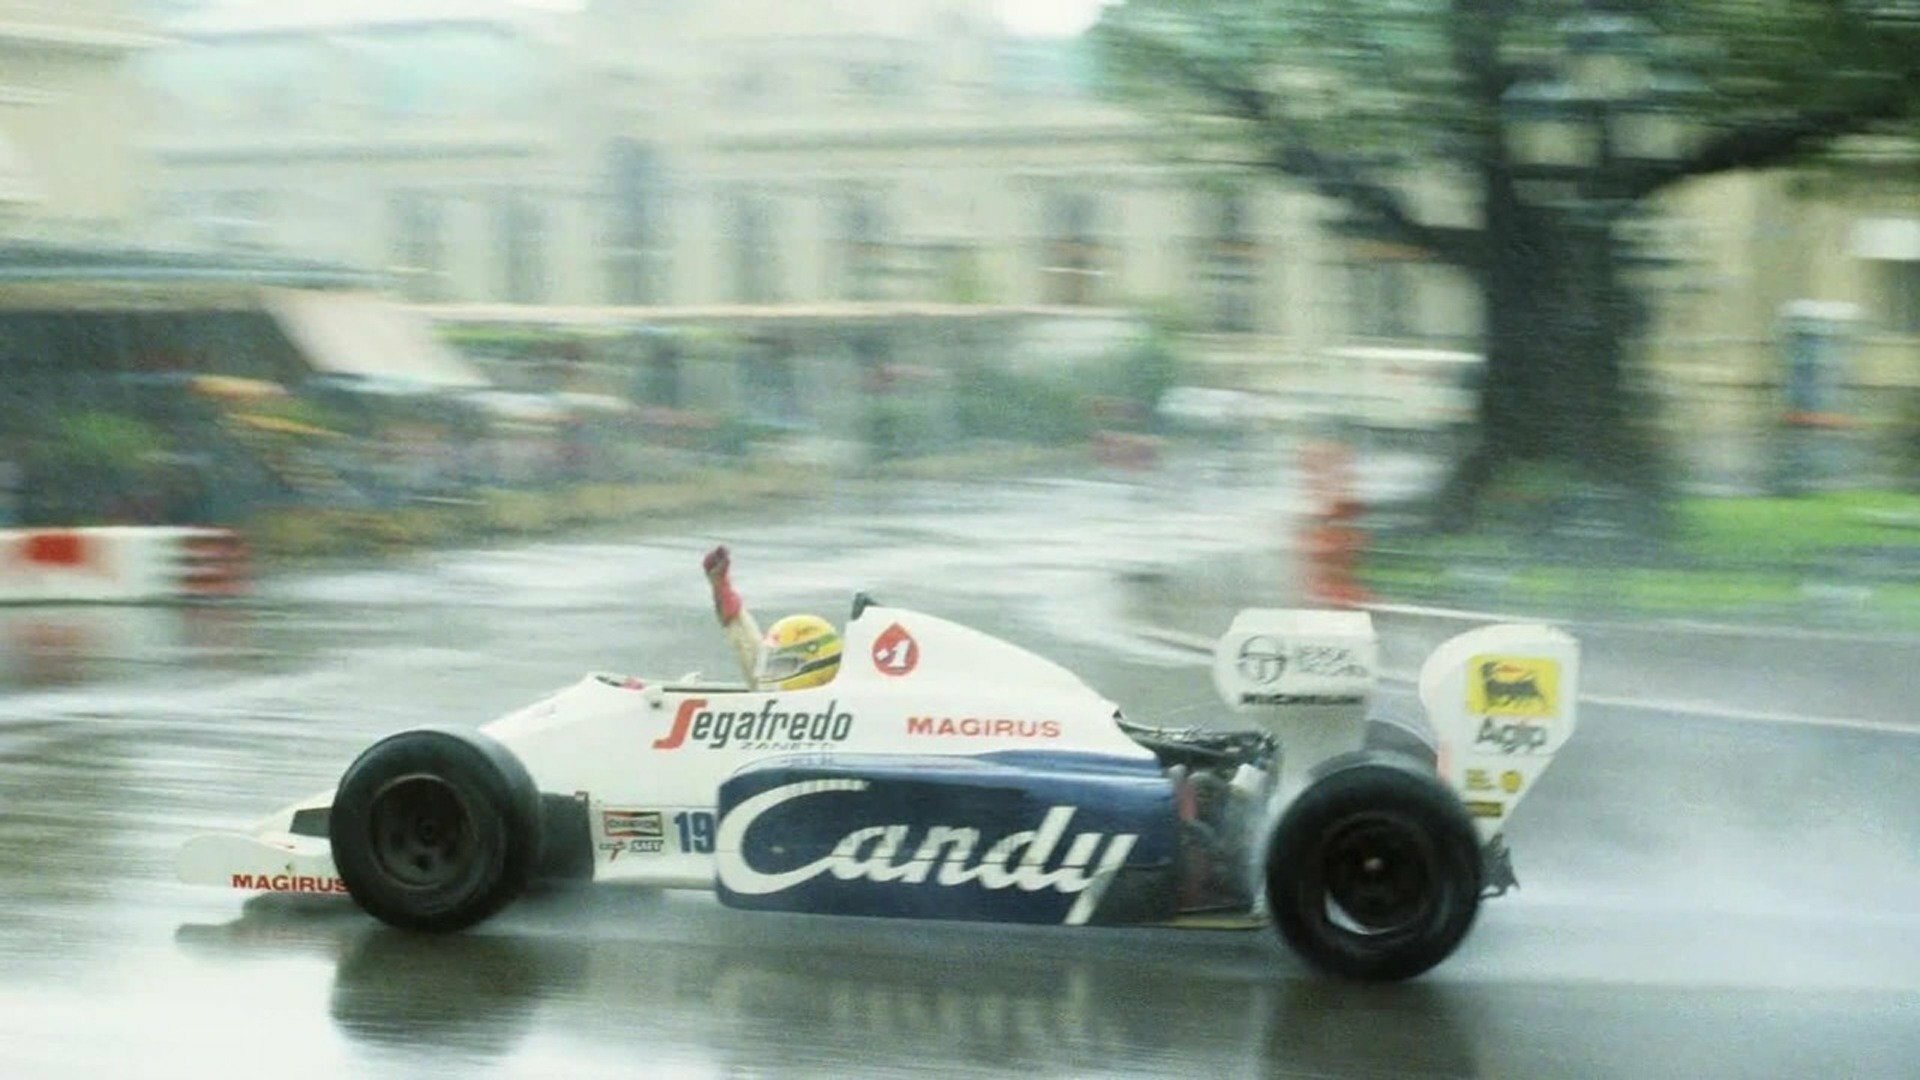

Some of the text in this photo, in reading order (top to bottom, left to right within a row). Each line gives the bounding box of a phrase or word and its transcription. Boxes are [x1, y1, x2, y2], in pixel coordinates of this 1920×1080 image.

[653, 699, 855, 749] Segafredo
[906, 716, 1062, 738] MAGIRUS
[1474, 718, 1548, 755] Agip
[674, 811, 716, 854] 19
[716, 778, 1140, 925] Candy
[232, 874, 349, 892] MAGIRUS
